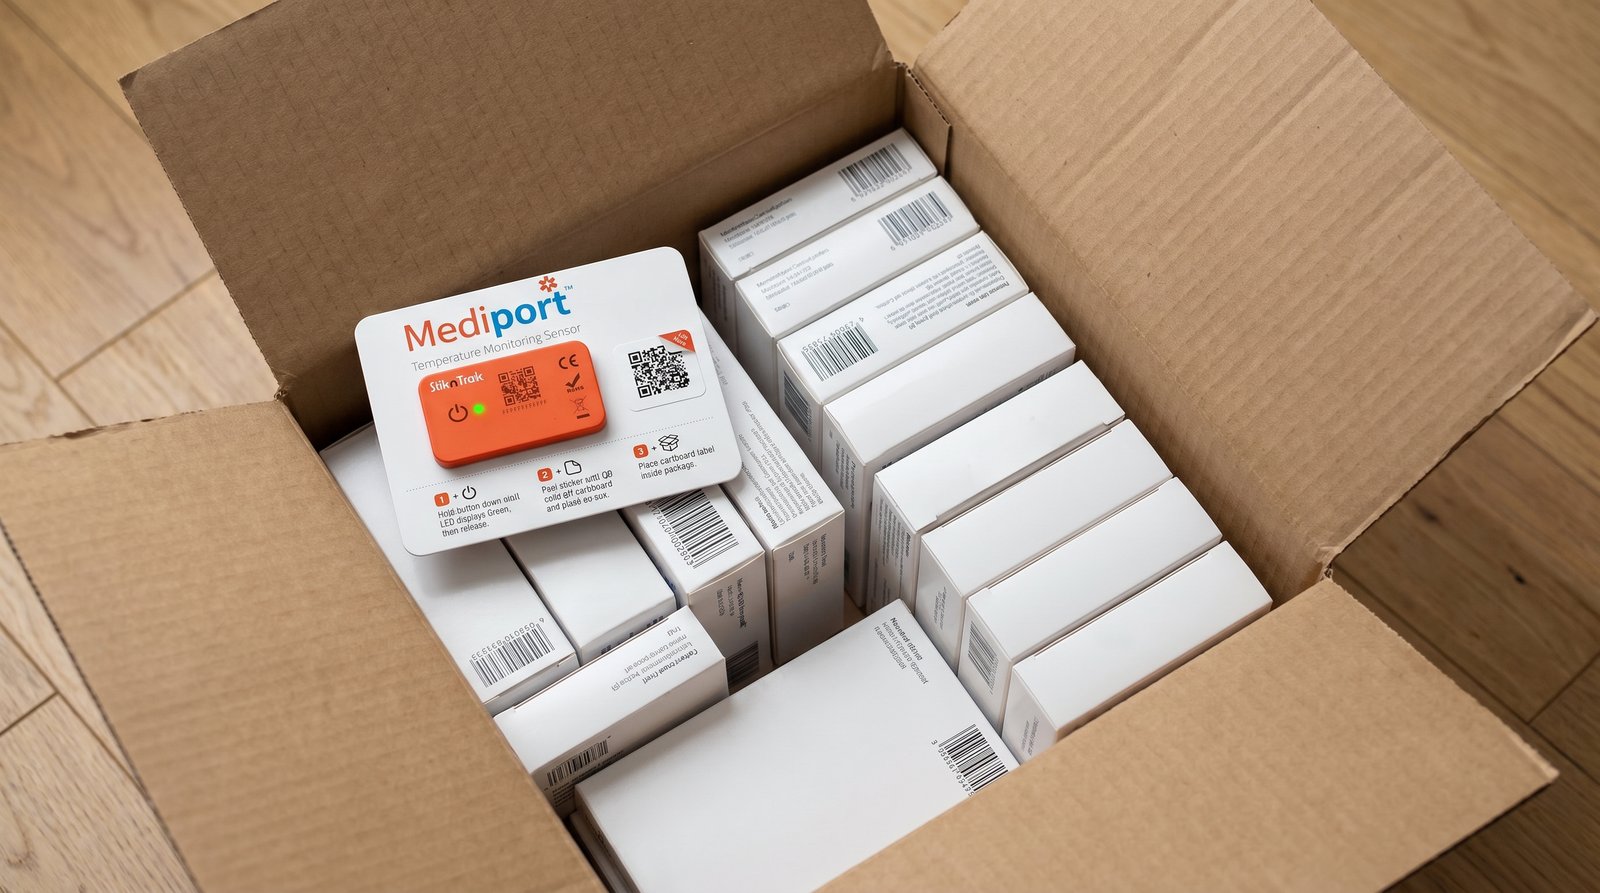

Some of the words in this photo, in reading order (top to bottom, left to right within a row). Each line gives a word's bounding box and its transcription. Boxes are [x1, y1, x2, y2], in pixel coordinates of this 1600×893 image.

[411, 348, 482, 372] Temperature
[483, 333, 543, 356] Monitoring
[543, 324, 582, 340] Sensor
[638, 460, 659, 471] Place
[641, 469, 663, 480] inside
[560, 478, 584, 490] sticker
[482, 498, 502, 510] down
[546, 504, 561, 513] and
[439, 517, 455, 528] LED
[456, 511, 486, 524] displays
[442, 528, 459, 537] then
